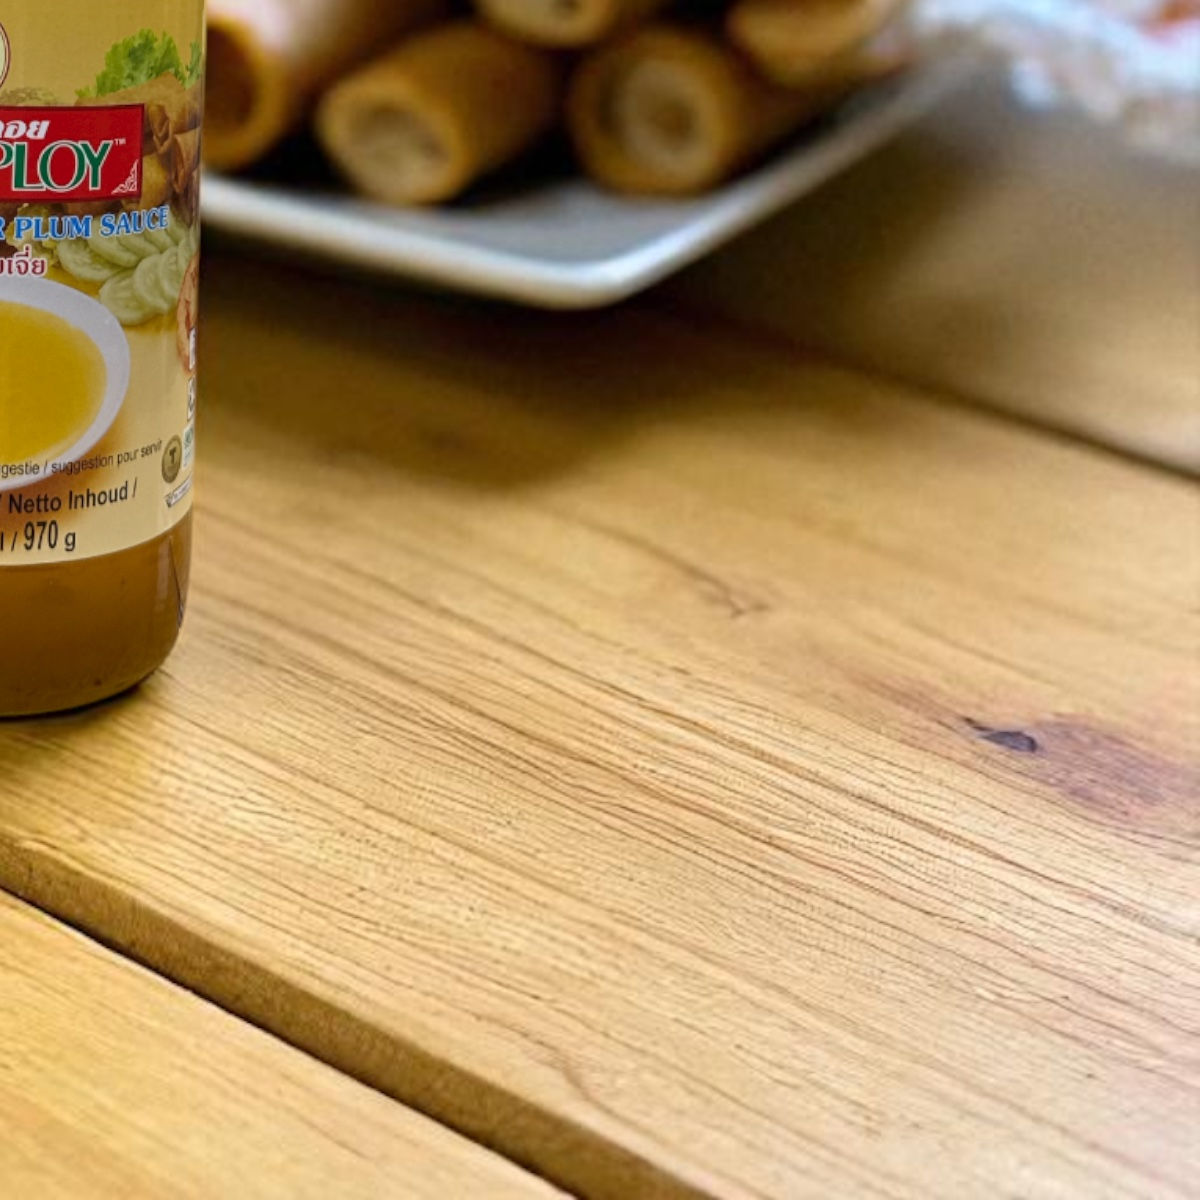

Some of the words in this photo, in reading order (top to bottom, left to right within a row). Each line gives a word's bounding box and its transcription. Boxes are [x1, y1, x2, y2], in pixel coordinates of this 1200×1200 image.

[15, 214, 91, 240] PLUM
[100, 204, 170, 237] SAUCE
[51, 453, 114, 475] suggestion
[117, 448, 139, 467] pour
[8, 492, 62, 514] Netto
[68, 480, 129, 510] Inhoud
[132, 477, 139, 498] /
[10, 531, 18, 552] /
[24, 520, 59, 550] 970
[64, 531, 76, 552] g
